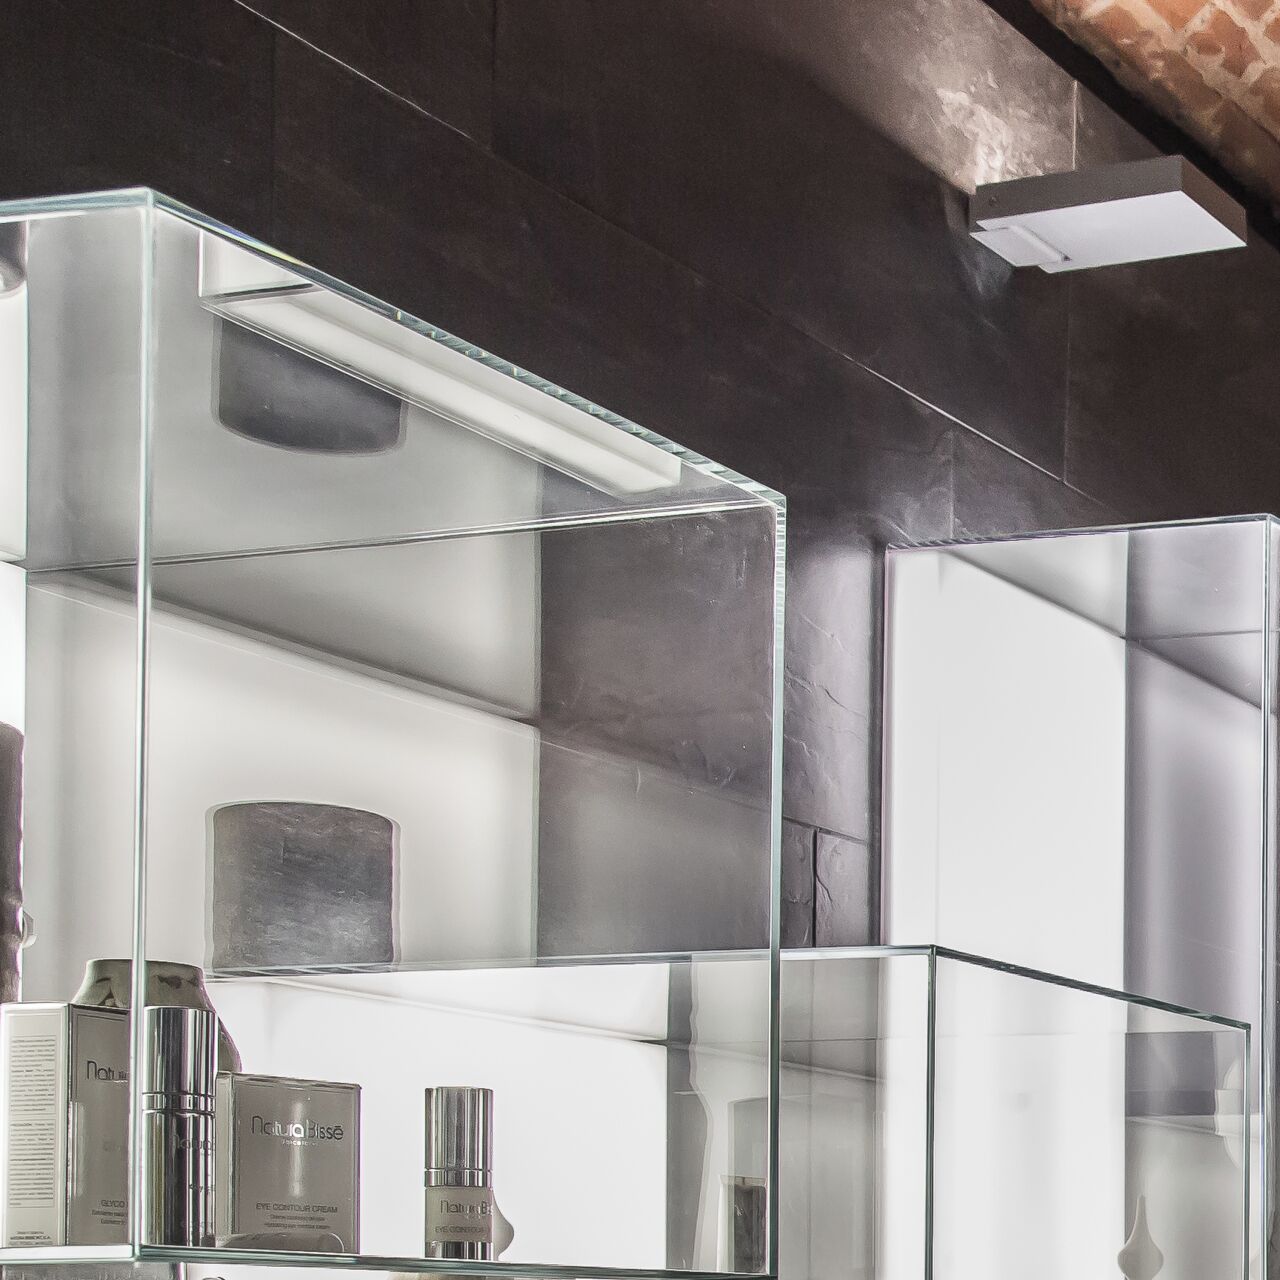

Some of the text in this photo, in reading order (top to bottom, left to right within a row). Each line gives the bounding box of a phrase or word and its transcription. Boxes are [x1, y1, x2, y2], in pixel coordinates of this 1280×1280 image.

[251, 1115, 305, 1138] Natura
[256, 1202, 271, 1211] EYE
[312, 1205, 338, 1214] CREAM
